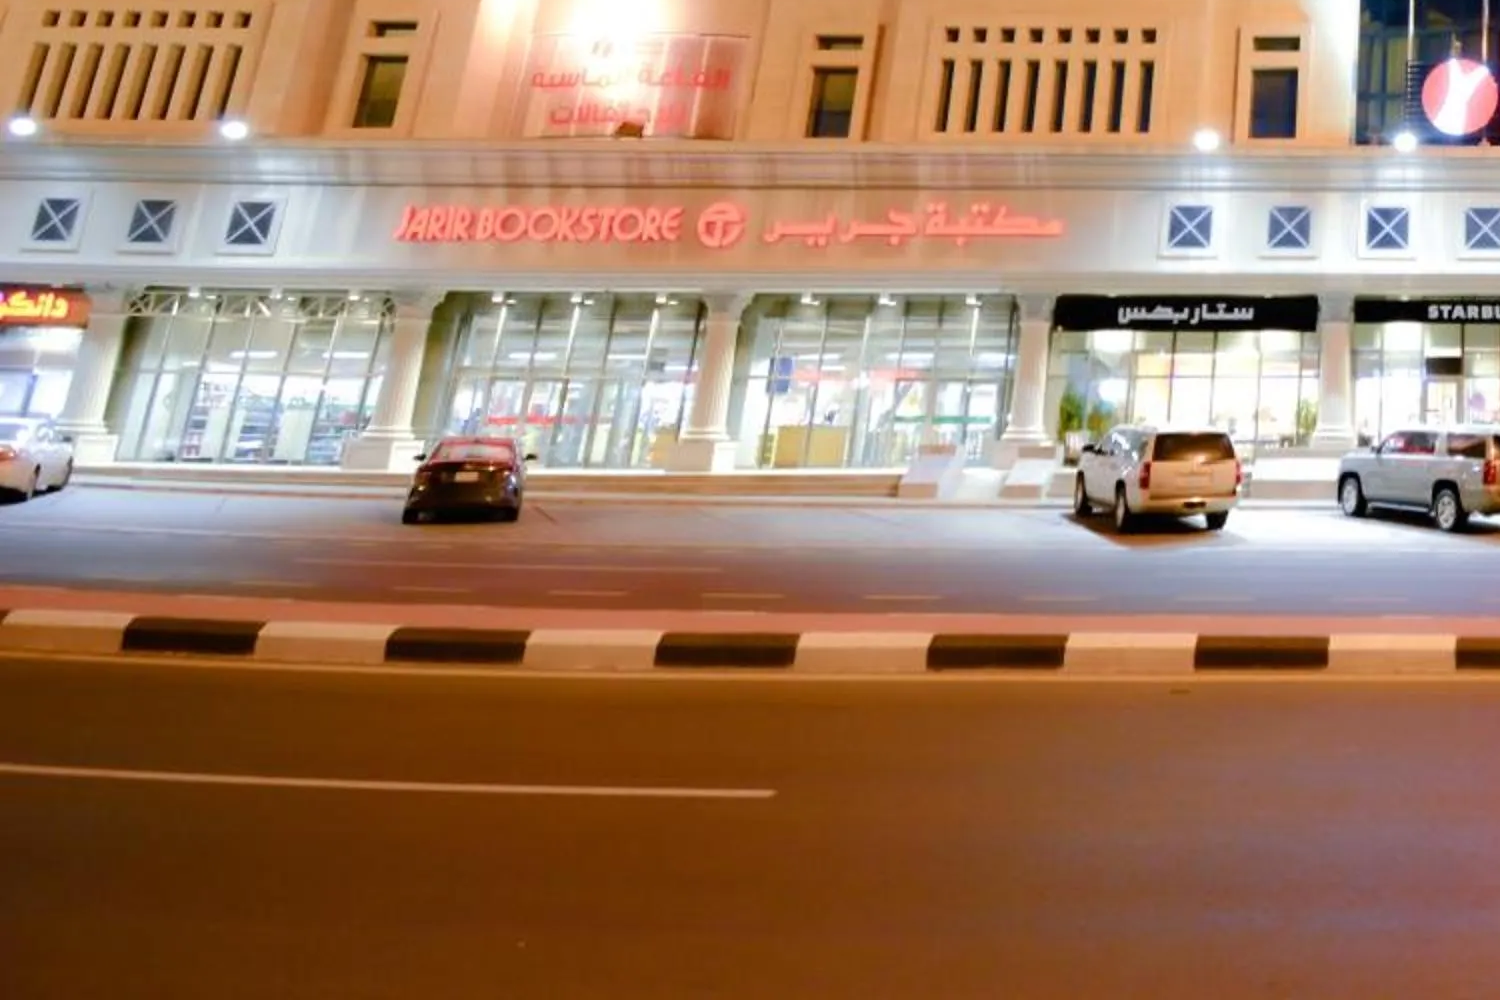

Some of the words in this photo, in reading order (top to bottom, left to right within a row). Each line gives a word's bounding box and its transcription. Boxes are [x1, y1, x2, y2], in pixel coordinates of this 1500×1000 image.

[392, 204, 474, 242] JARIR
[474, 204, 684, 243] BOOKSTORE
[762, 208, 917, 248] جرير
[923, 200, 1066, 247] مكتبة
[1117, 302, 1255, 325] ستاربكس
